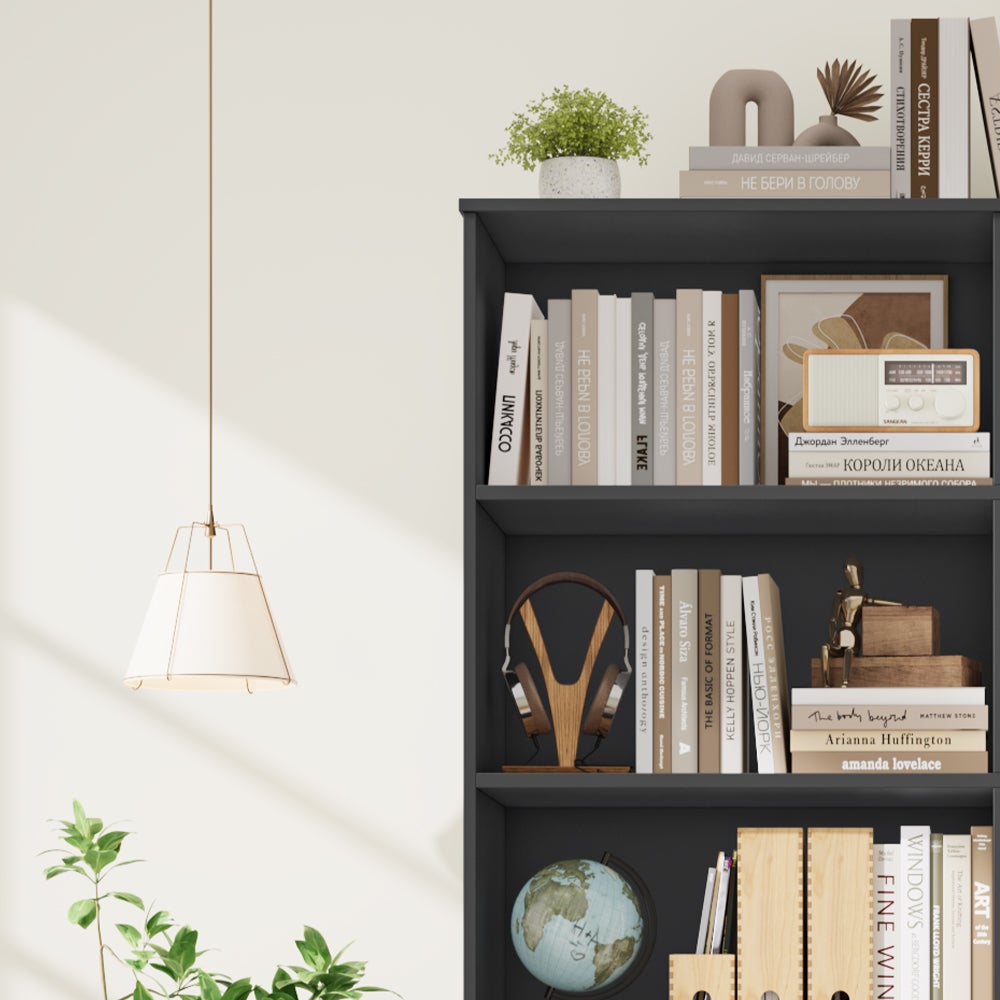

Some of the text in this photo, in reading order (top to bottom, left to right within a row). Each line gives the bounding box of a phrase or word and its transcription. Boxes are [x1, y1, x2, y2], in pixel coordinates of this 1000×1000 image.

[896, 86, 906, 171] СТИХОТВОРЕНИЯ
[917, 82, 931, 177] СЕСТРА КЕРРИ
[731, 151, 851, 165] ДАВИД СЕРВАН-ШРЕЙБЕР
[741, 176, 862, 191] НЕ БЕРИ В ГОЛОВУ
[795, 436, 889, 447] Джордан Элленберг
[843, 458, 965, 472] КОРОЛИ ОКЕАНА
[679, 600, 693, 663] Álvaro Siza
[704, 613, 714, 730] THE BASIC OF FORMAT
[726, 620, 736, 742] KELLY HOPPEN STYLE
[752, 661, 771, 756] НЬЮ-ЙОРК
[808, 710, 832, 722] The
[837, 707, 862, 722] body
[868, 709, 908, 728] beyond
[825, 732, 952, 748] Arianna Huffington
[842, 757, 942, 770] amanda lovelace
[876, 875, 895, 932] FINE
[906, 833, 924, 929] WINDOWS
[974, 880, 991, 919] ART
[932, 905, 941, 989] FRANK LLOYD WRIGHT
